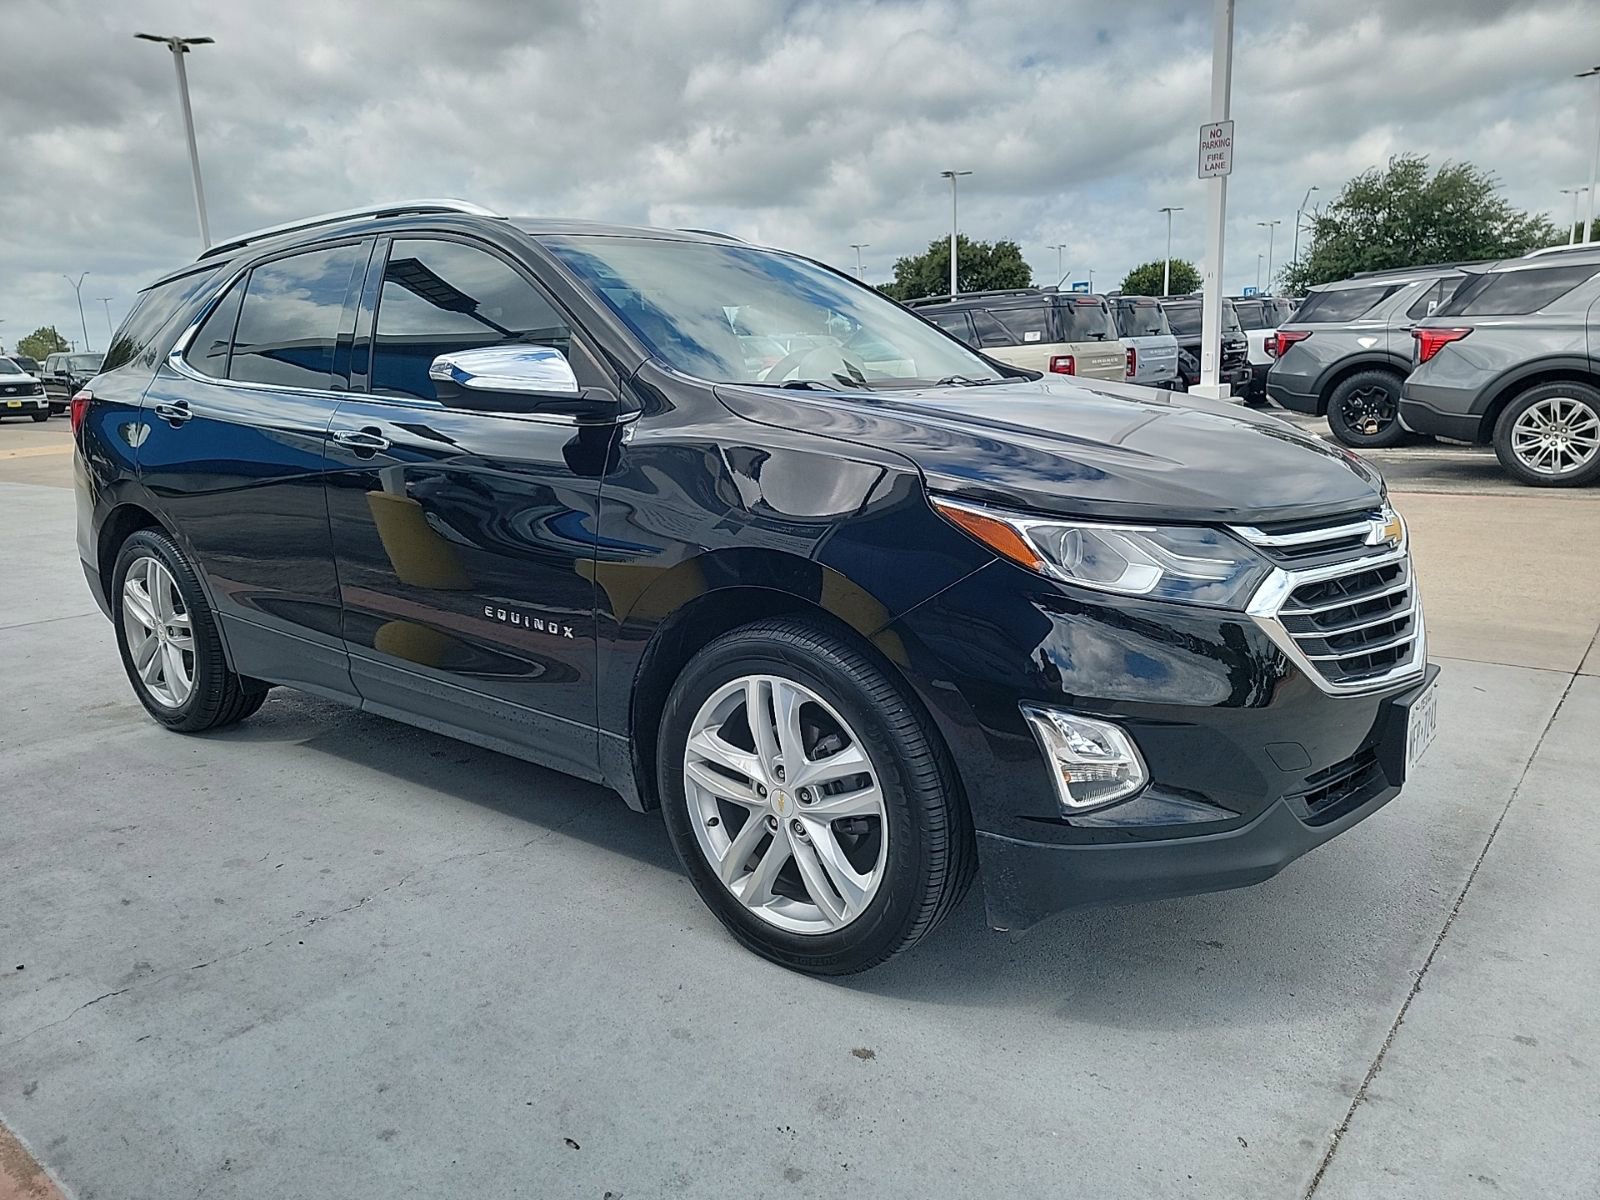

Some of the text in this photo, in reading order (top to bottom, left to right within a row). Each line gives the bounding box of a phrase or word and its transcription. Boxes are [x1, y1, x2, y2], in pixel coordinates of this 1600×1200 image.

[1209, 128, 1223, 139] NO
[1202, 138, 1231, 151] PARKING
[1207, 152, 1225, 161] FIRE
[1204, 161, 1226, 171] LANE
[484, 606, 574, 639] EQUINOX
